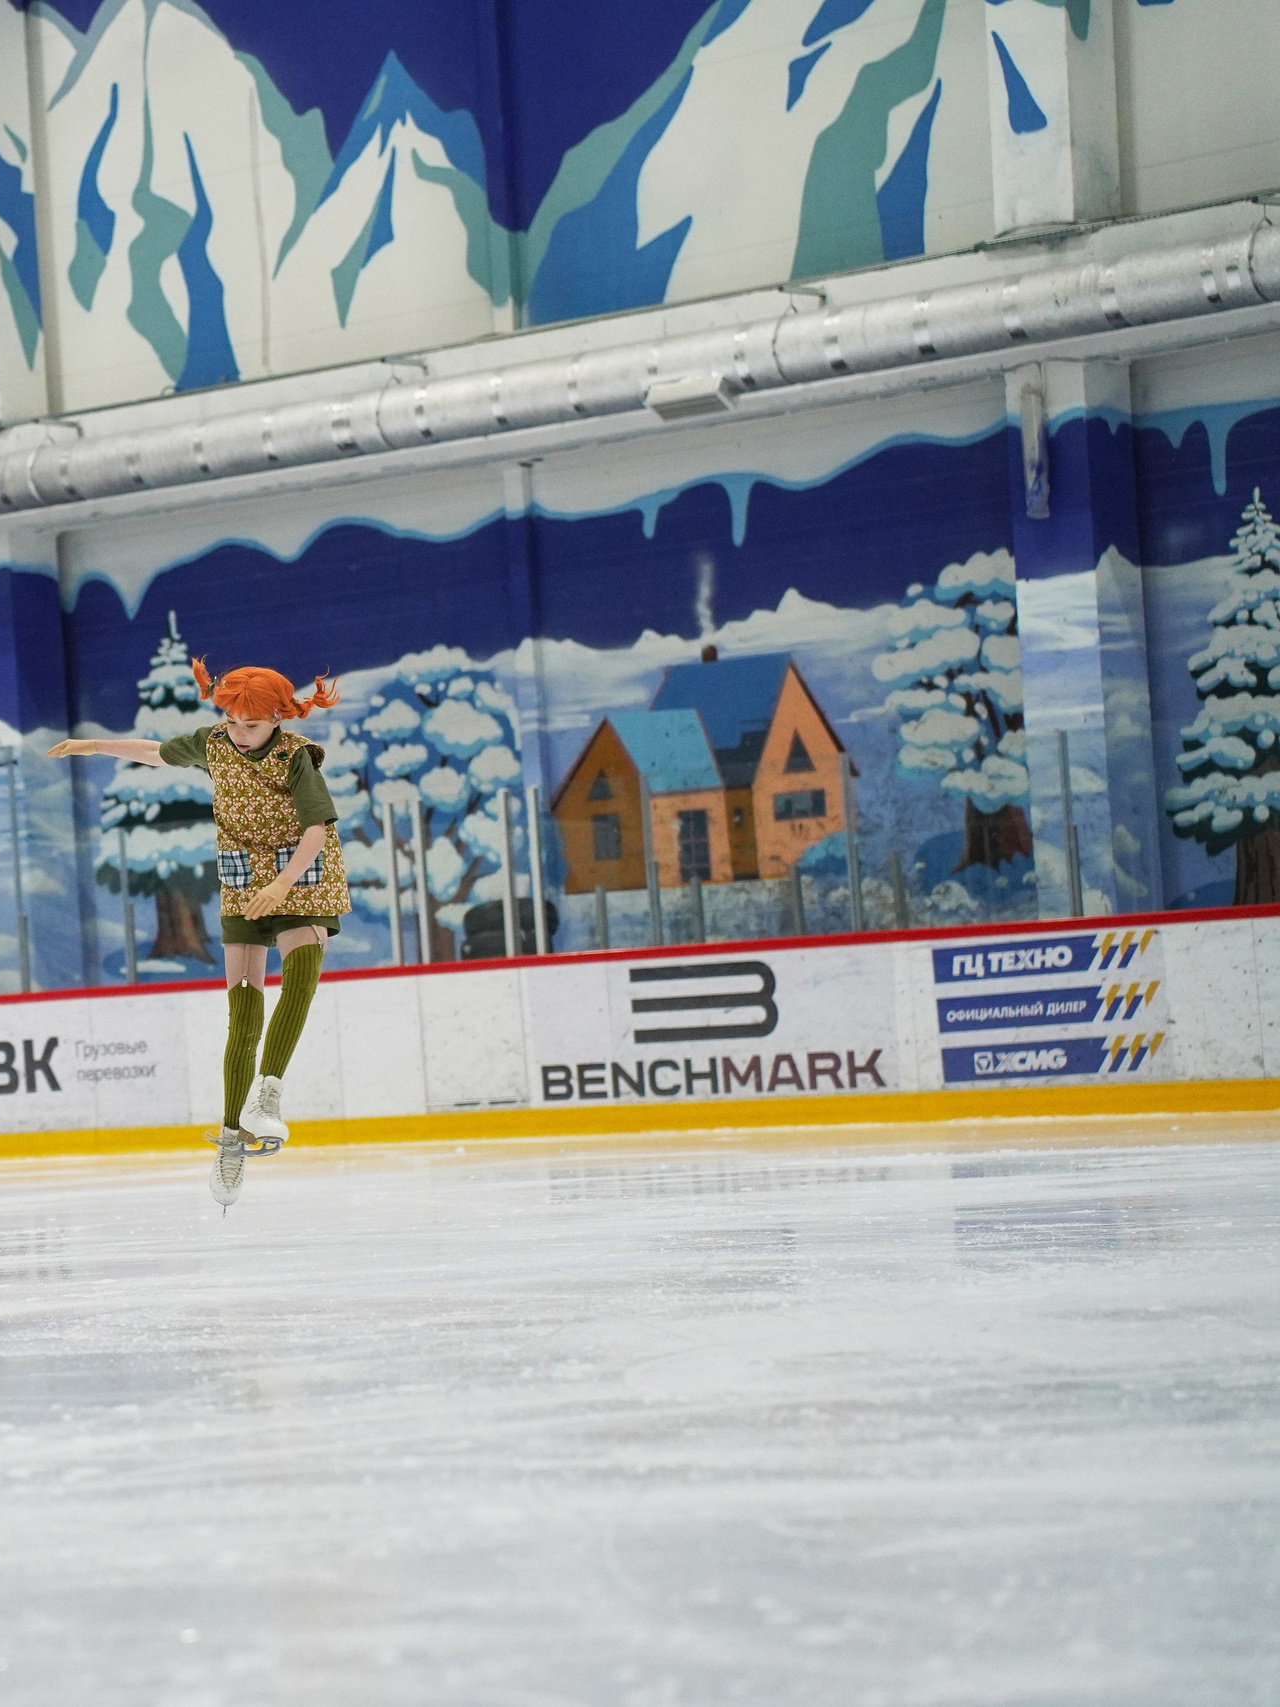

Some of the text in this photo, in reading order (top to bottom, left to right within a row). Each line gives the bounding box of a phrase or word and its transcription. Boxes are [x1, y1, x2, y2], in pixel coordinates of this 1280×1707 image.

[952, 945, 1073, 978] ГЦ ТЕХНО
[946, 1000, 1087, 1023] ОФИЦИАЛЬНЫЙ ДИЛЕР
[74, 1038, 148, 1061] Грузовые
[995, 1048, 1068, 1074] XCMG
[76, 1063, 158, 1084] перевозки
[541, 1048, 887, 1101] BENCHMARK
